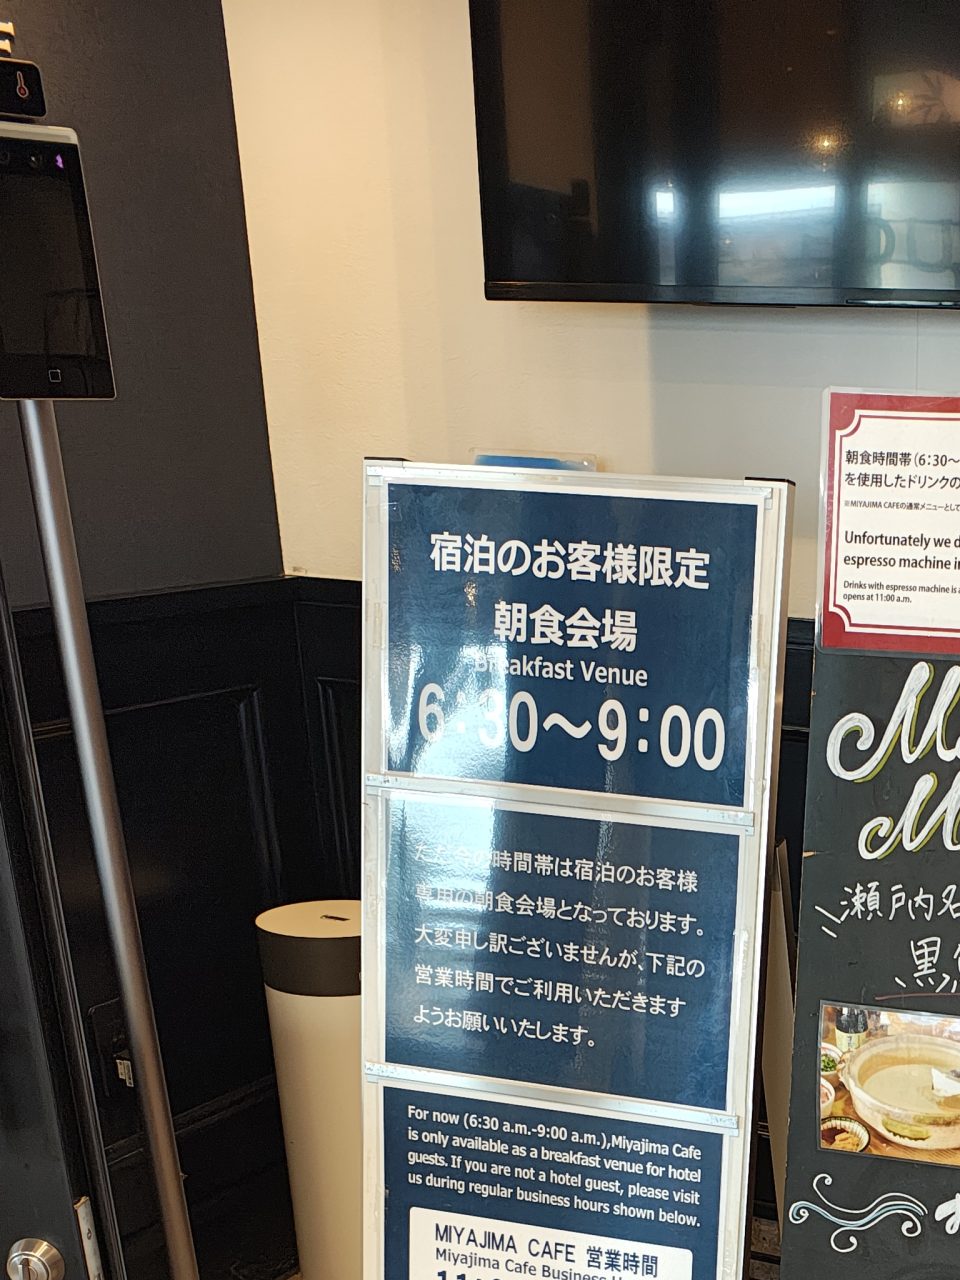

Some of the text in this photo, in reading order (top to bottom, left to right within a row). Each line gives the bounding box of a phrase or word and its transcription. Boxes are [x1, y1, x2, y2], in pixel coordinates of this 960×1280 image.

[429, 531, 711, 590] 宿泊のお客様限定
[843, 555, 896, 569] espresso
[899, 555, 951, 570] machine
[844, 530, 931, 550] Unfortunately
[933, 538, 951, 548] we
[843, 580, 867, 590] Drinks
[868, 581, 884, 590] with
[885, 583, 917, 593] espresso
[918, 584, 950, 594] machine
[951, 585, 957, 594] is
[843, 593, 865, 602] opens
[876, 593, 895, 602] 11:00
[493, 601, 638, 653] 朝食会場
[476, 653, 648, 687] Brakfast Venue
[415, 842, 698, 893] た時間帯は宿泊のお客様
[414, 884, 704, 936] 専用の朝食会場となっております。
[414, 926, 706, 979] 大変申し訳ございませんが、下記の
[414, 964, 687, 1018] 営業時間でご利用いただきます
[413, 1006, 596, 1047] ようお願いいたします。
[407, 1105, 702, 1160] For now (6:30 a.m.-9:00 a.m.),Miyajima Cafe
[408, 1127, 702, 1182] is only available as a breakfast venue for hotel
[408, 1151, 700, 1205] guests. If you are not a hotel guest, please visit
[408, 1173, 701, 1227] us during regular business hours shown below.
[435, 1223, 659, 1279] MIYAJIMA CAFE 営業時間
[435, 1247, 500, 1270] Miyajima
[504, 1259, 537, 1276] Cafe
